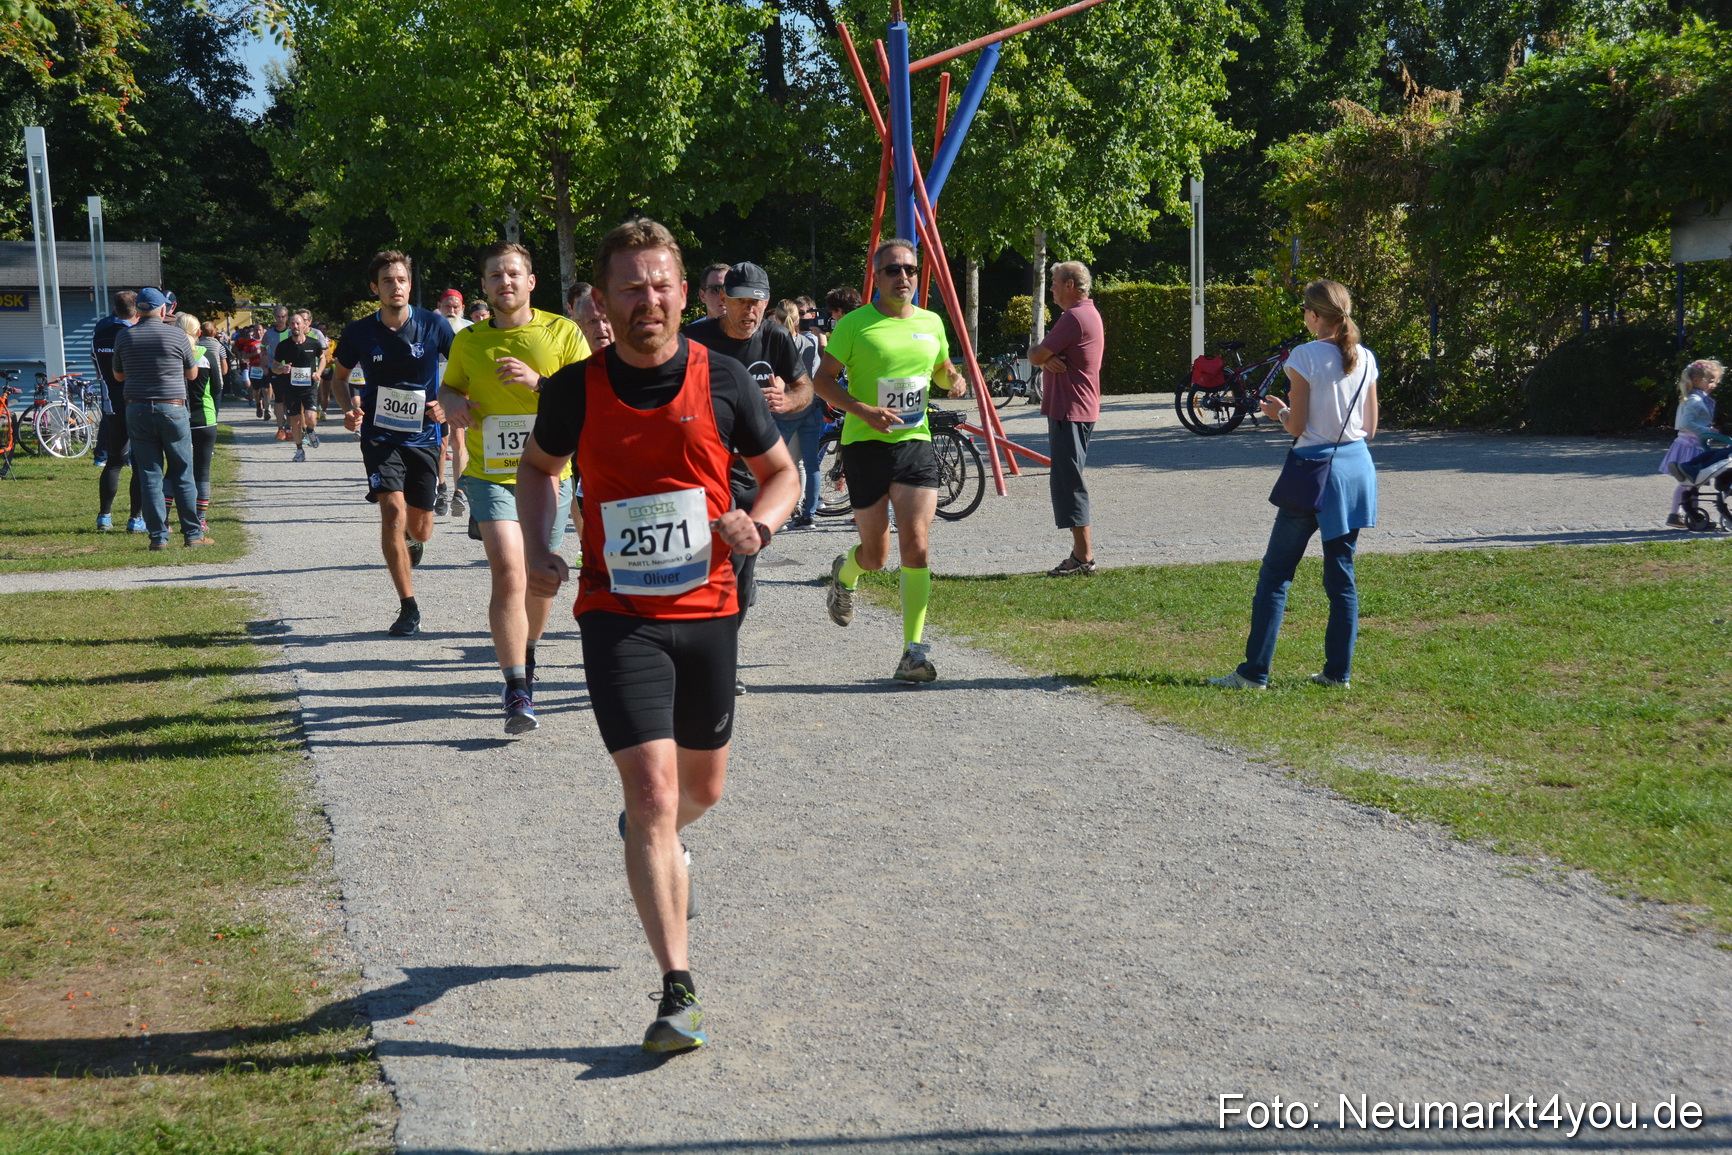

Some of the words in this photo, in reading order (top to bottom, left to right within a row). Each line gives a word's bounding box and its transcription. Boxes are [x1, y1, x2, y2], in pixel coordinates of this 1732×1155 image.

[372, 354, 383, 363] PM
[383, 397, 417, 415] 3040
[886, 390, 922, 408] 2164
[499, 420, 527, 428] BOCK
[628, 502, 677, 519] BOCK
[620, 519, 691, 557] 2571
[651, 556, 683, 566] Neumarkt
[643, 572, 680, 585] Oliver
